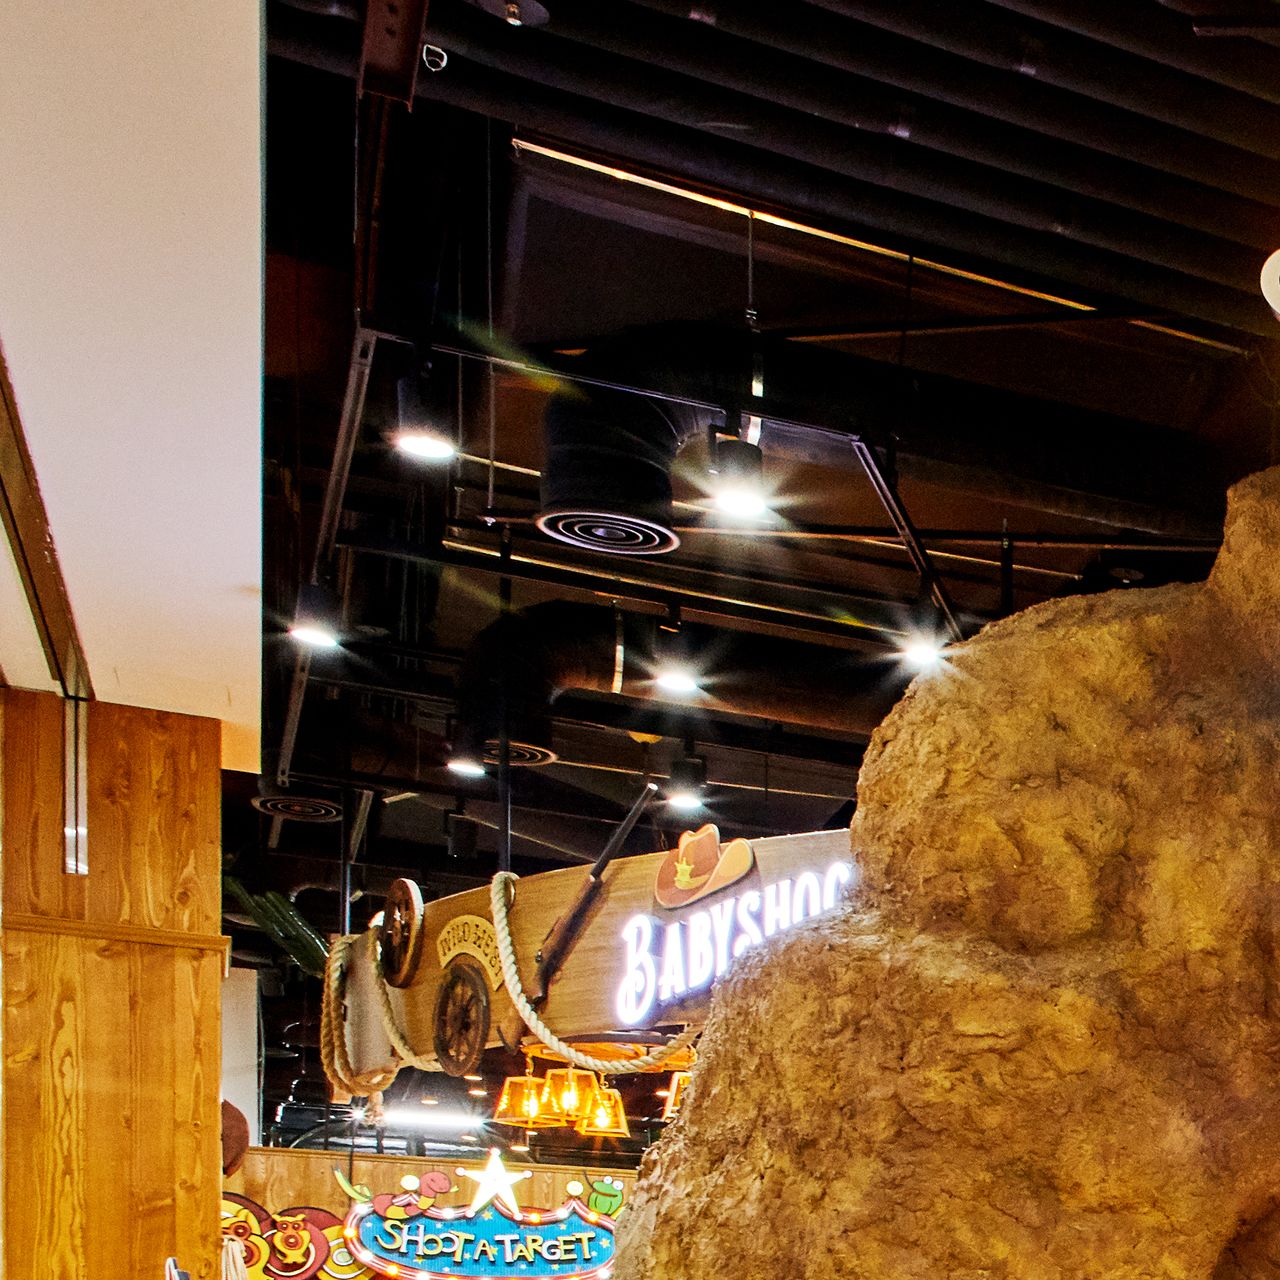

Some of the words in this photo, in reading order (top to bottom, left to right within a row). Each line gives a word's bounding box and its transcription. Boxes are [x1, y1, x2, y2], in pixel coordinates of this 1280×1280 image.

[375, 1219, 475, 1263] SHOOT
[474, 1239, 495, 1263] A
[495, 1231, 596, 1263] TARGET
